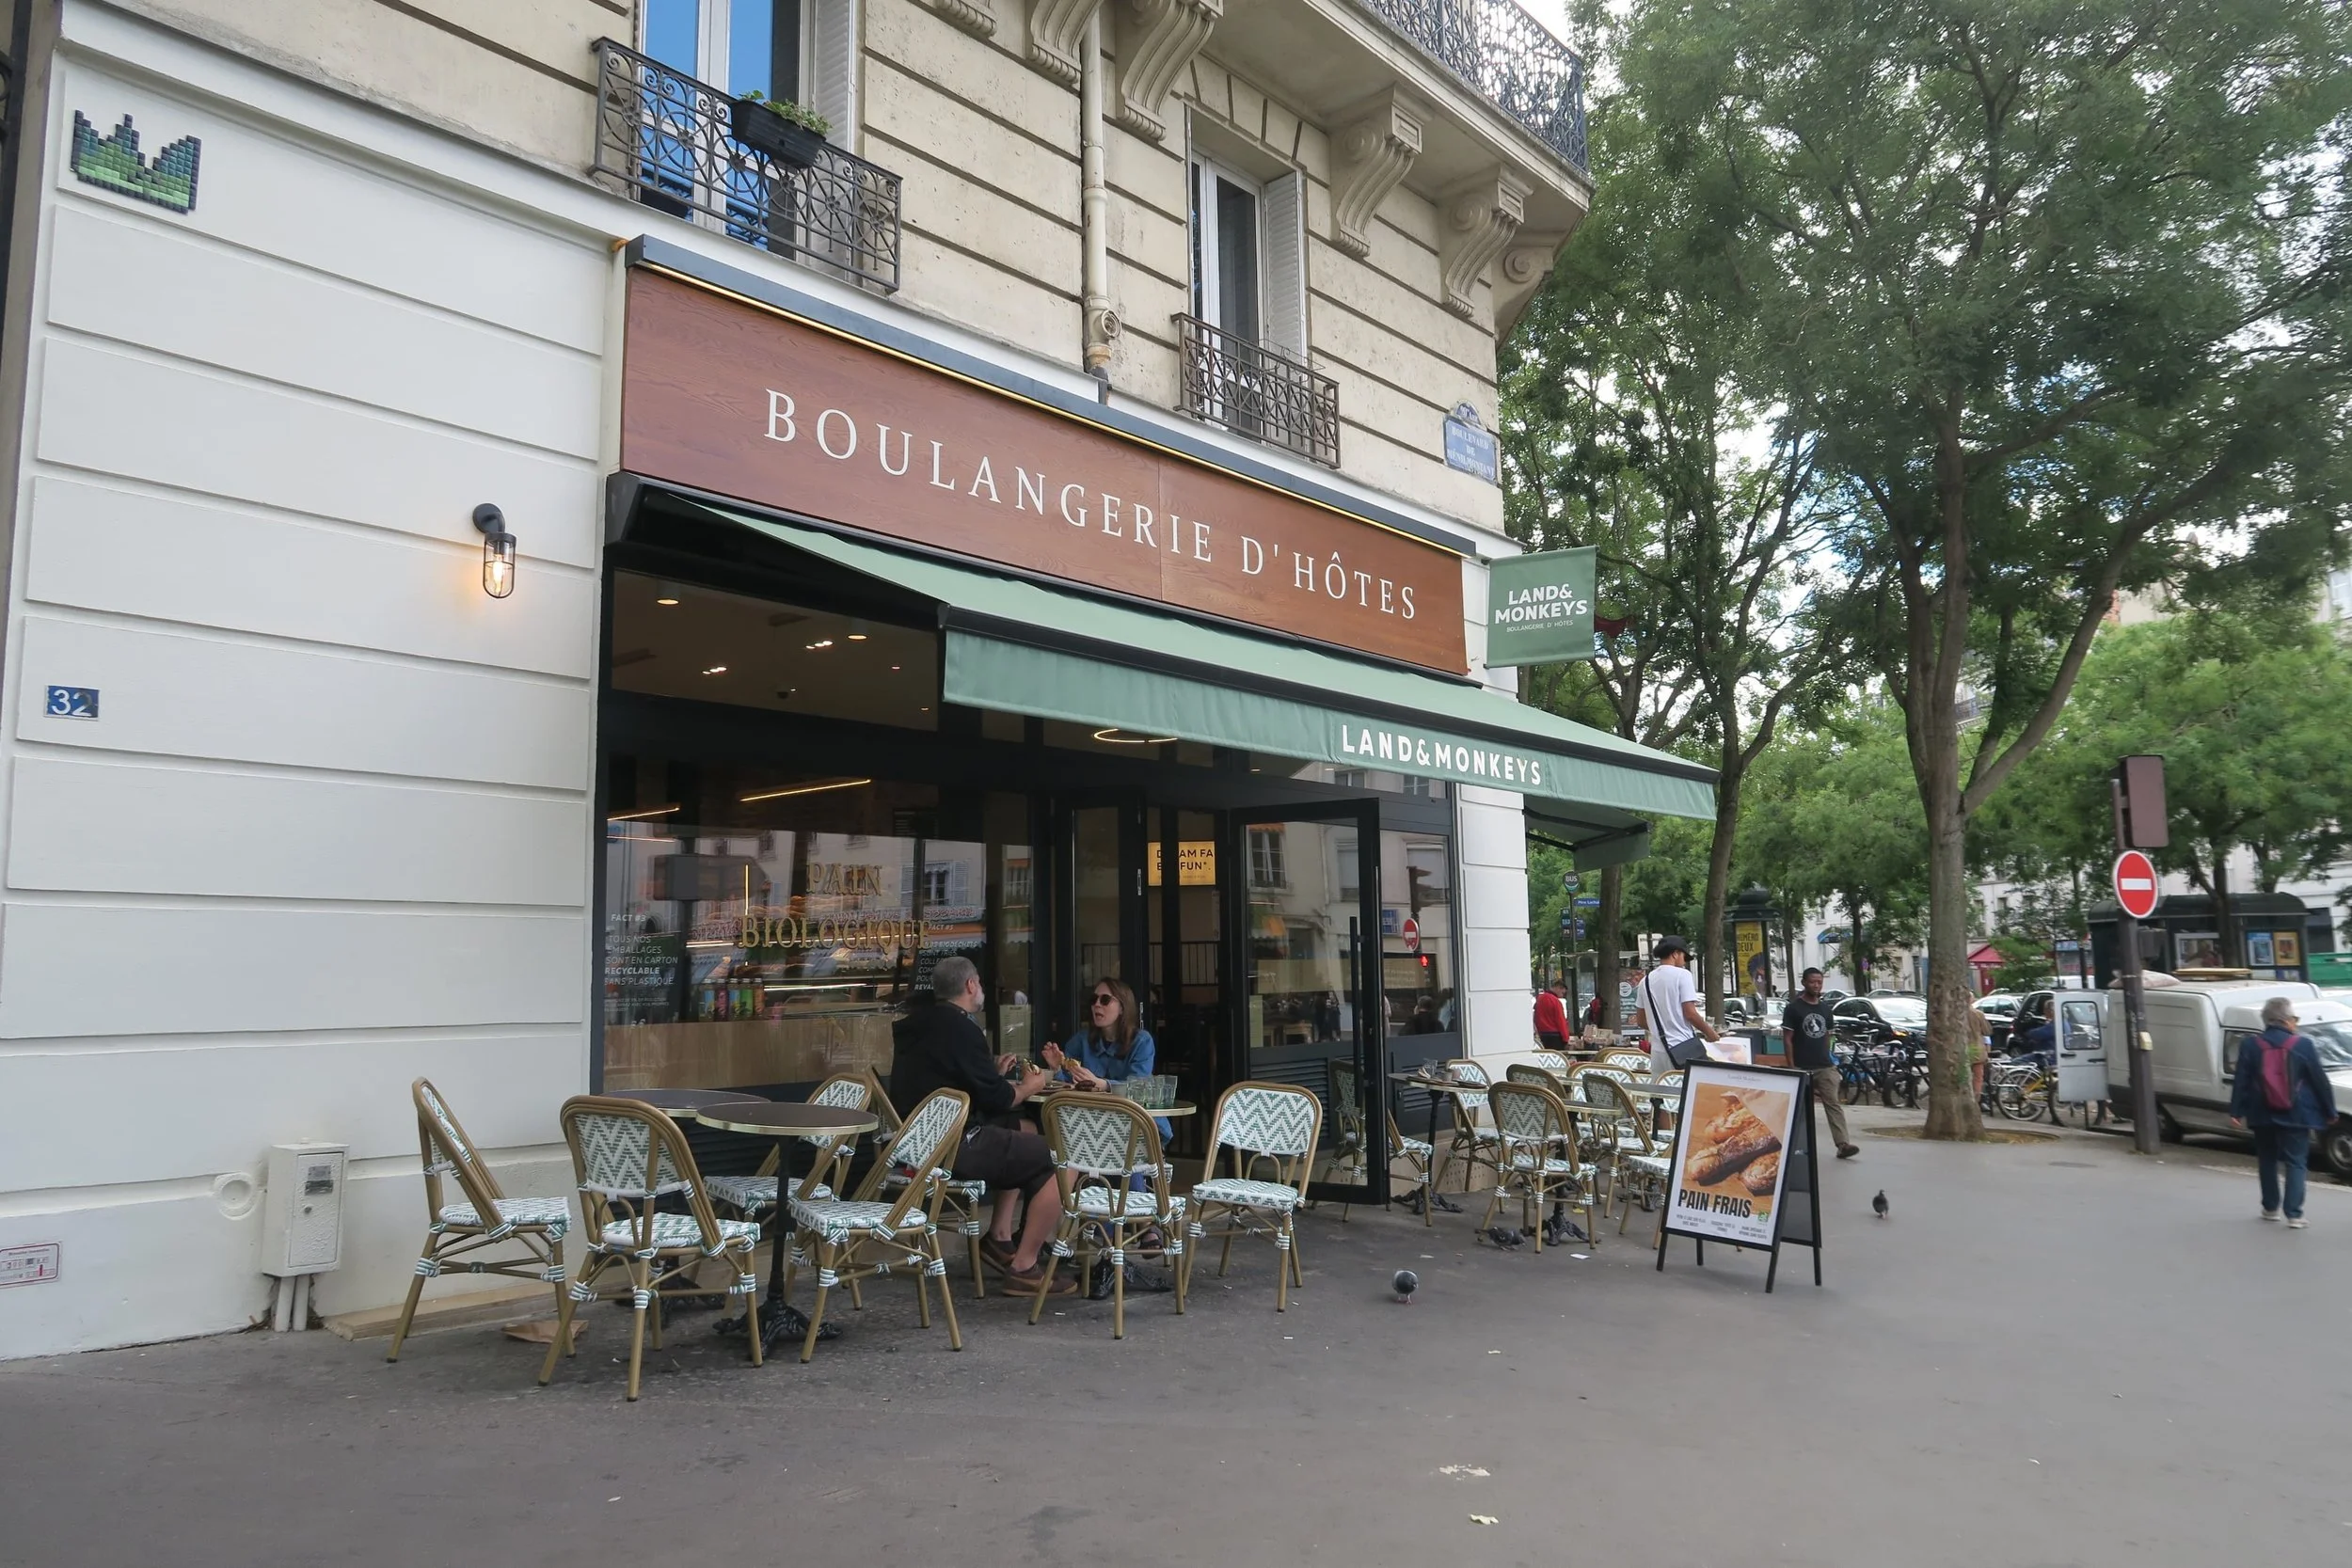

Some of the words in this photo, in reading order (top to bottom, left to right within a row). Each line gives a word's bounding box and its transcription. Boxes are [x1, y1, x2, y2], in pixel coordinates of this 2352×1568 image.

[1452, 426, 1489, 450] BOULEVARD
[1466, 445, 1476, 456] DE
[764, 388, 1211, 562] BOULANGERIE
[1241, 535, 1415, 619] D'HÔTES
[1508, 583, 1573, 605] LAND&
[1495, 599, 1588, 624] MONKEYS
[1506, 623, 1545, 633] BOULANGERIE
[52, 689, 92, 717] 32
[1342, 724, 1541, 785] LAND&MONKEYS
[806, 862, 882, 895] PAIN
[609, 935, 631, 943] TOUS
[633, 935, 651, 943] NOS
[738, 914, 932, 955] BIOLOGIQUE
[605, 956, 629, 964] SONT
[631, 956, 643, 964] EN
[644, 956, 678, 964] CARTON
[608, 945, 662, 954] EMBALLAGES
[604, 977, 627, 986] SANS
[628, 977, 674, 987] PLASTIQUE
[1677, 1189, 1710, 1212] PAIN
[1712, 1195, 1752, 1218] FRAIS
